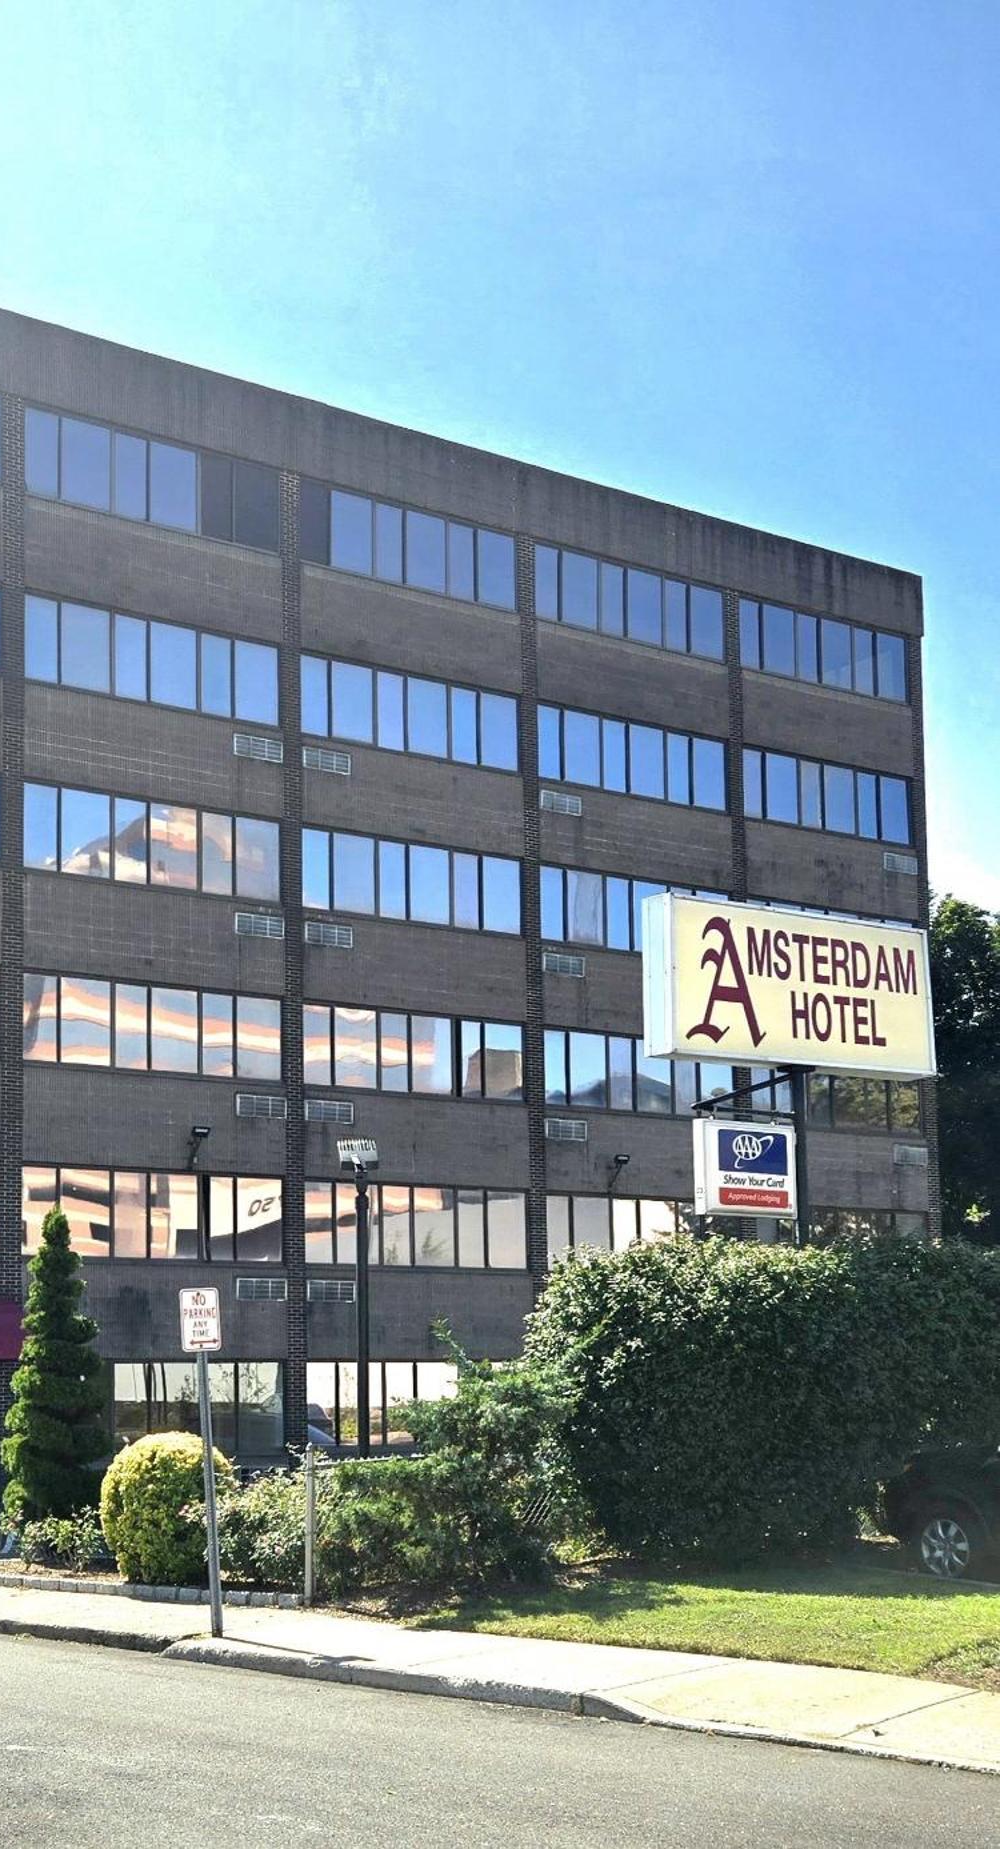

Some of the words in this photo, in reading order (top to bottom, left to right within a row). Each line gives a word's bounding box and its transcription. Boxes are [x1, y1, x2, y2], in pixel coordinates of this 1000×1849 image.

[686, 916, 918, 1047] AMSTERDAM
[790, 990, 887, 1047] HOTEL
[735, 1135, 760, 1160] AAA
[723, 1174, 747, 1186] Show
[748, 1176, 765, 1186] Your
[766, 1178, 785, 1188] Card
[727, 1192, 756, 1203] Approved
[757, 1194, 781, 1204] Lodging
[191, 1294, 206, 1306] NO
[183, 1307, 216, 1319] PARKING
[193, 1320, 208, 1329] ANY
[192, 1329, 209, 1338] TIME
